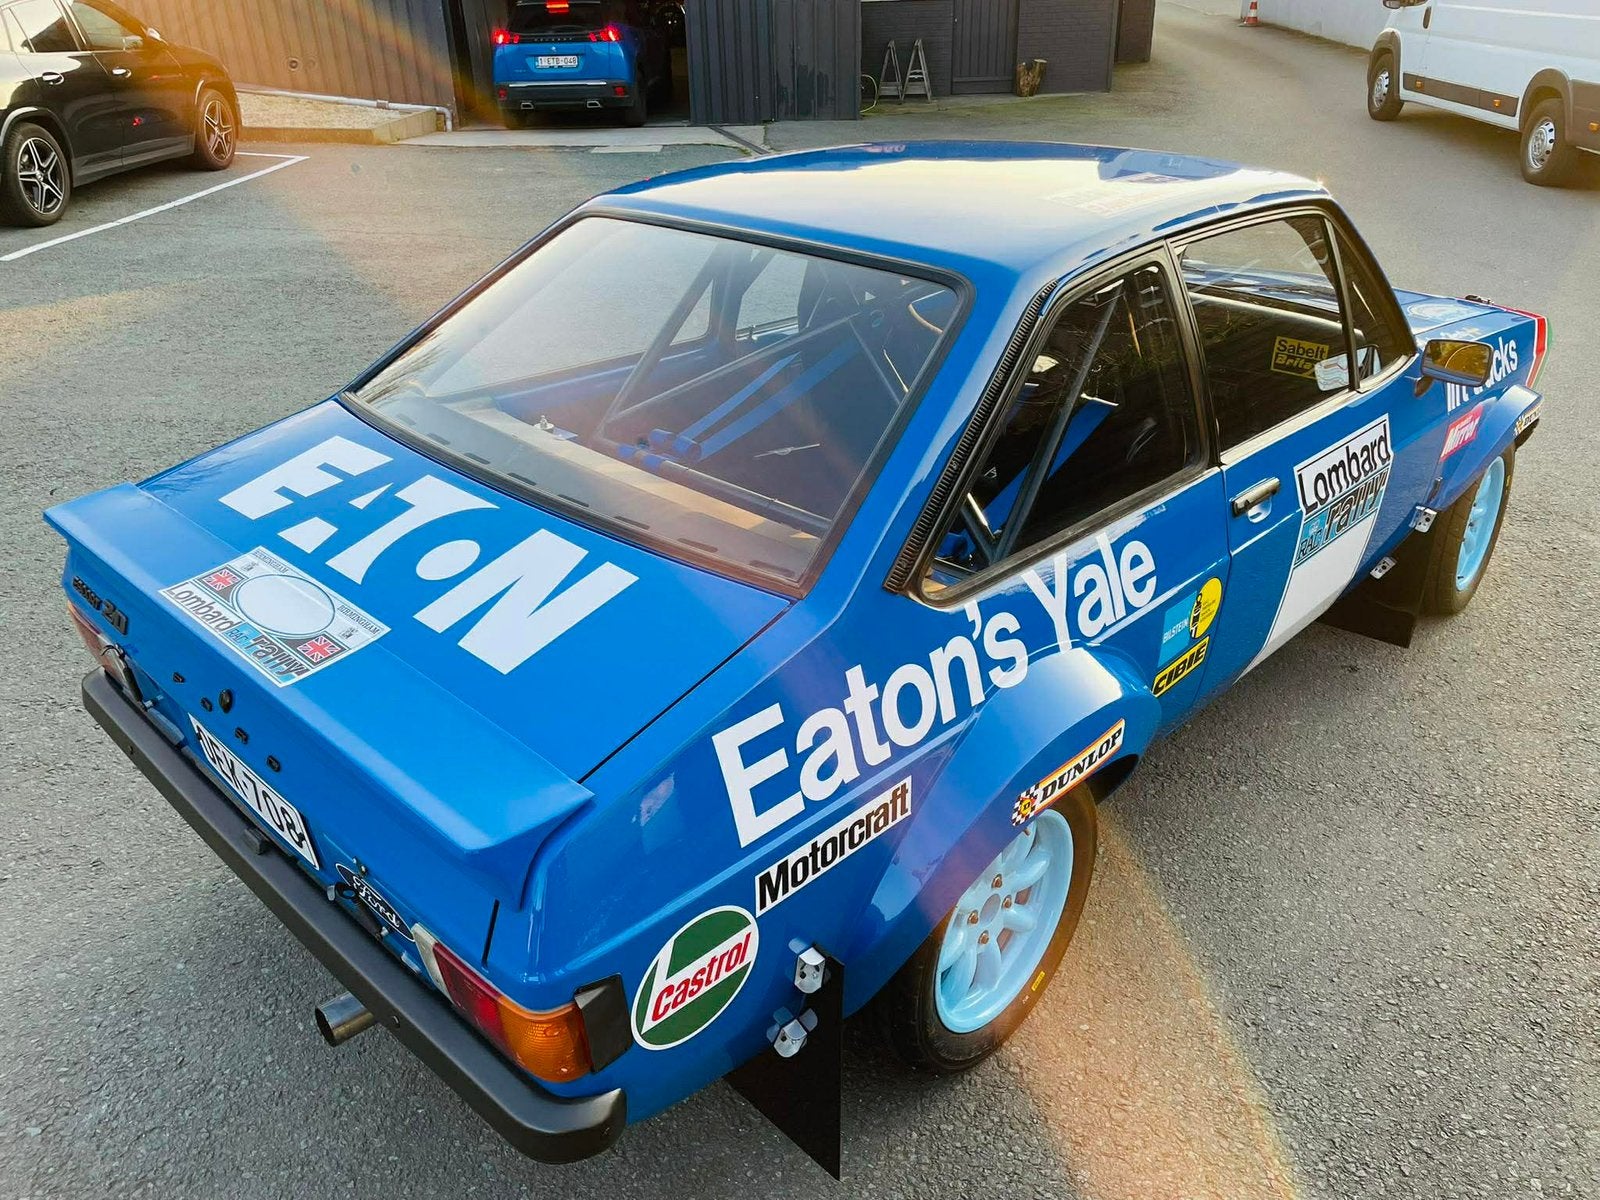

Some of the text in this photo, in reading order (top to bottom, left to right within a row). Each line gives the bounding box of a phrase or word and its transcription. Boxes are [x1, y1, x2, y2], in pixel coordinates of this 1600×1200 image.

[1275, 353, 1316, 371] Brita
[1276, 339, 1327, 359] Sabelt
[1298, 423, 1391, 516] Lombard
[1324, 469, 1390, 542] rally
[218, 434, 640, 676] EATON
[252, 550, 290, 575] BIRMINGHAM
[166, 582, 243, 633] Lombard
[245, 634, 312, 678] rally
[336, 603, 382, 636] BIRMINGHAM
[1162, 617, 1191, 645] BILSTEIN
[711, 532, 1158, 849] Eaton's Yale
[1040, 726, 1123, 804] DUNLOP
[758, 782, 910, 912] Motorcraft
[352, 875, 400, 928] Ford
[651, 931, 753, 1023] Castrol
